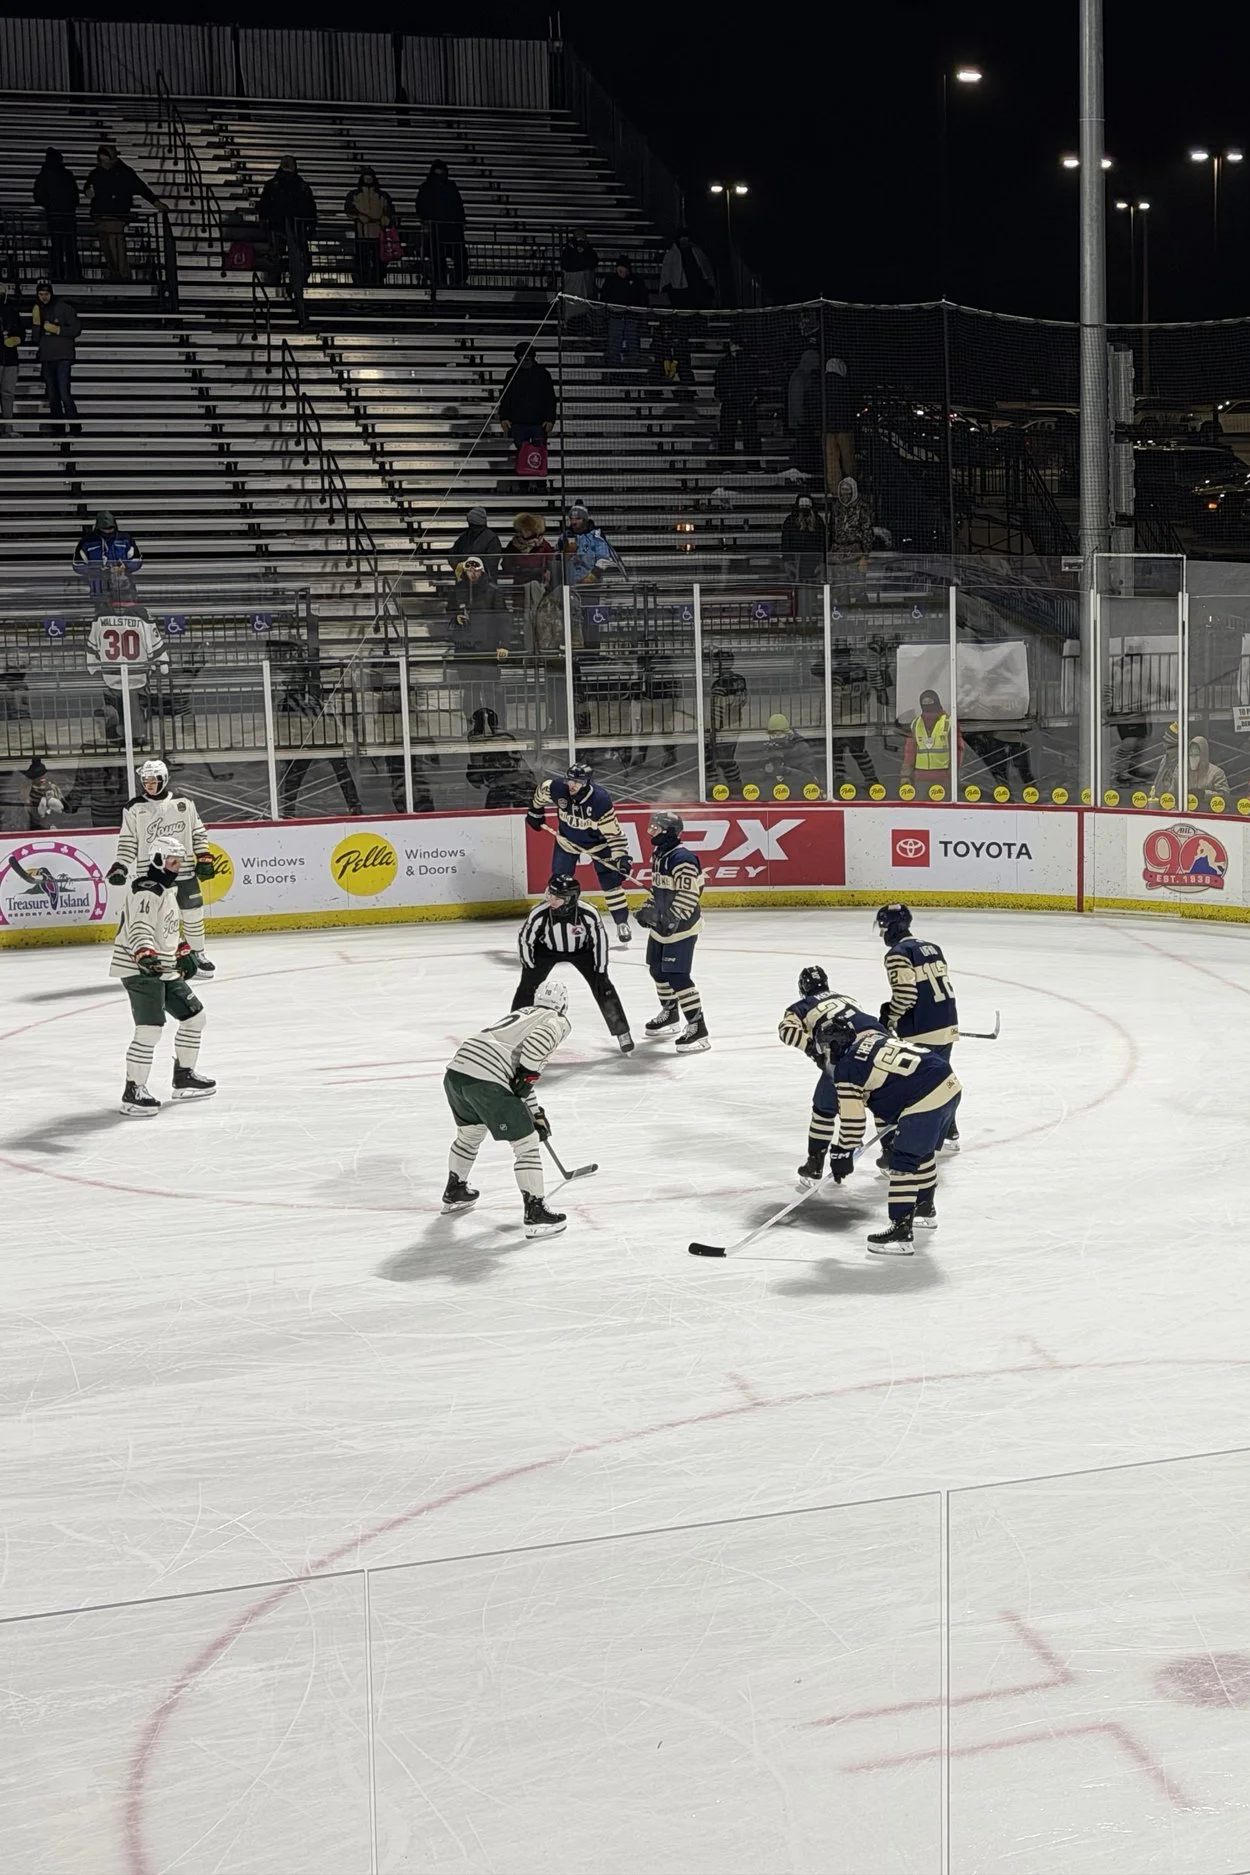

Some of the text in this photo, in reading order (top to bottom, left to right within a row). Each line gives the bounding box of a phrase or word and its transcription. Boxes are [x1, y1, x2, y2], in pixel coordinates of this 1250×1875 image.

[103, 629, 140, 661] 30
[586, 806, 593, 816] C
[146, 817, 186, 843] Iowa
[405, 848, 466, 860] Windows
[938, 840, 1033, 860] TOYOTA
[241, 857, 305, 869] Windows
[335, 845, 394, 880] Pella
[405, 864, 457, 876] & Doors
[242, 873, 296, 885] & Doors
[678, 876, 692, 890] 19
[1156, 874, 1211, 884] EST. 1936
[6, 895, 90, 912] Treasure Island
[139, 899, 150, 914] 16
